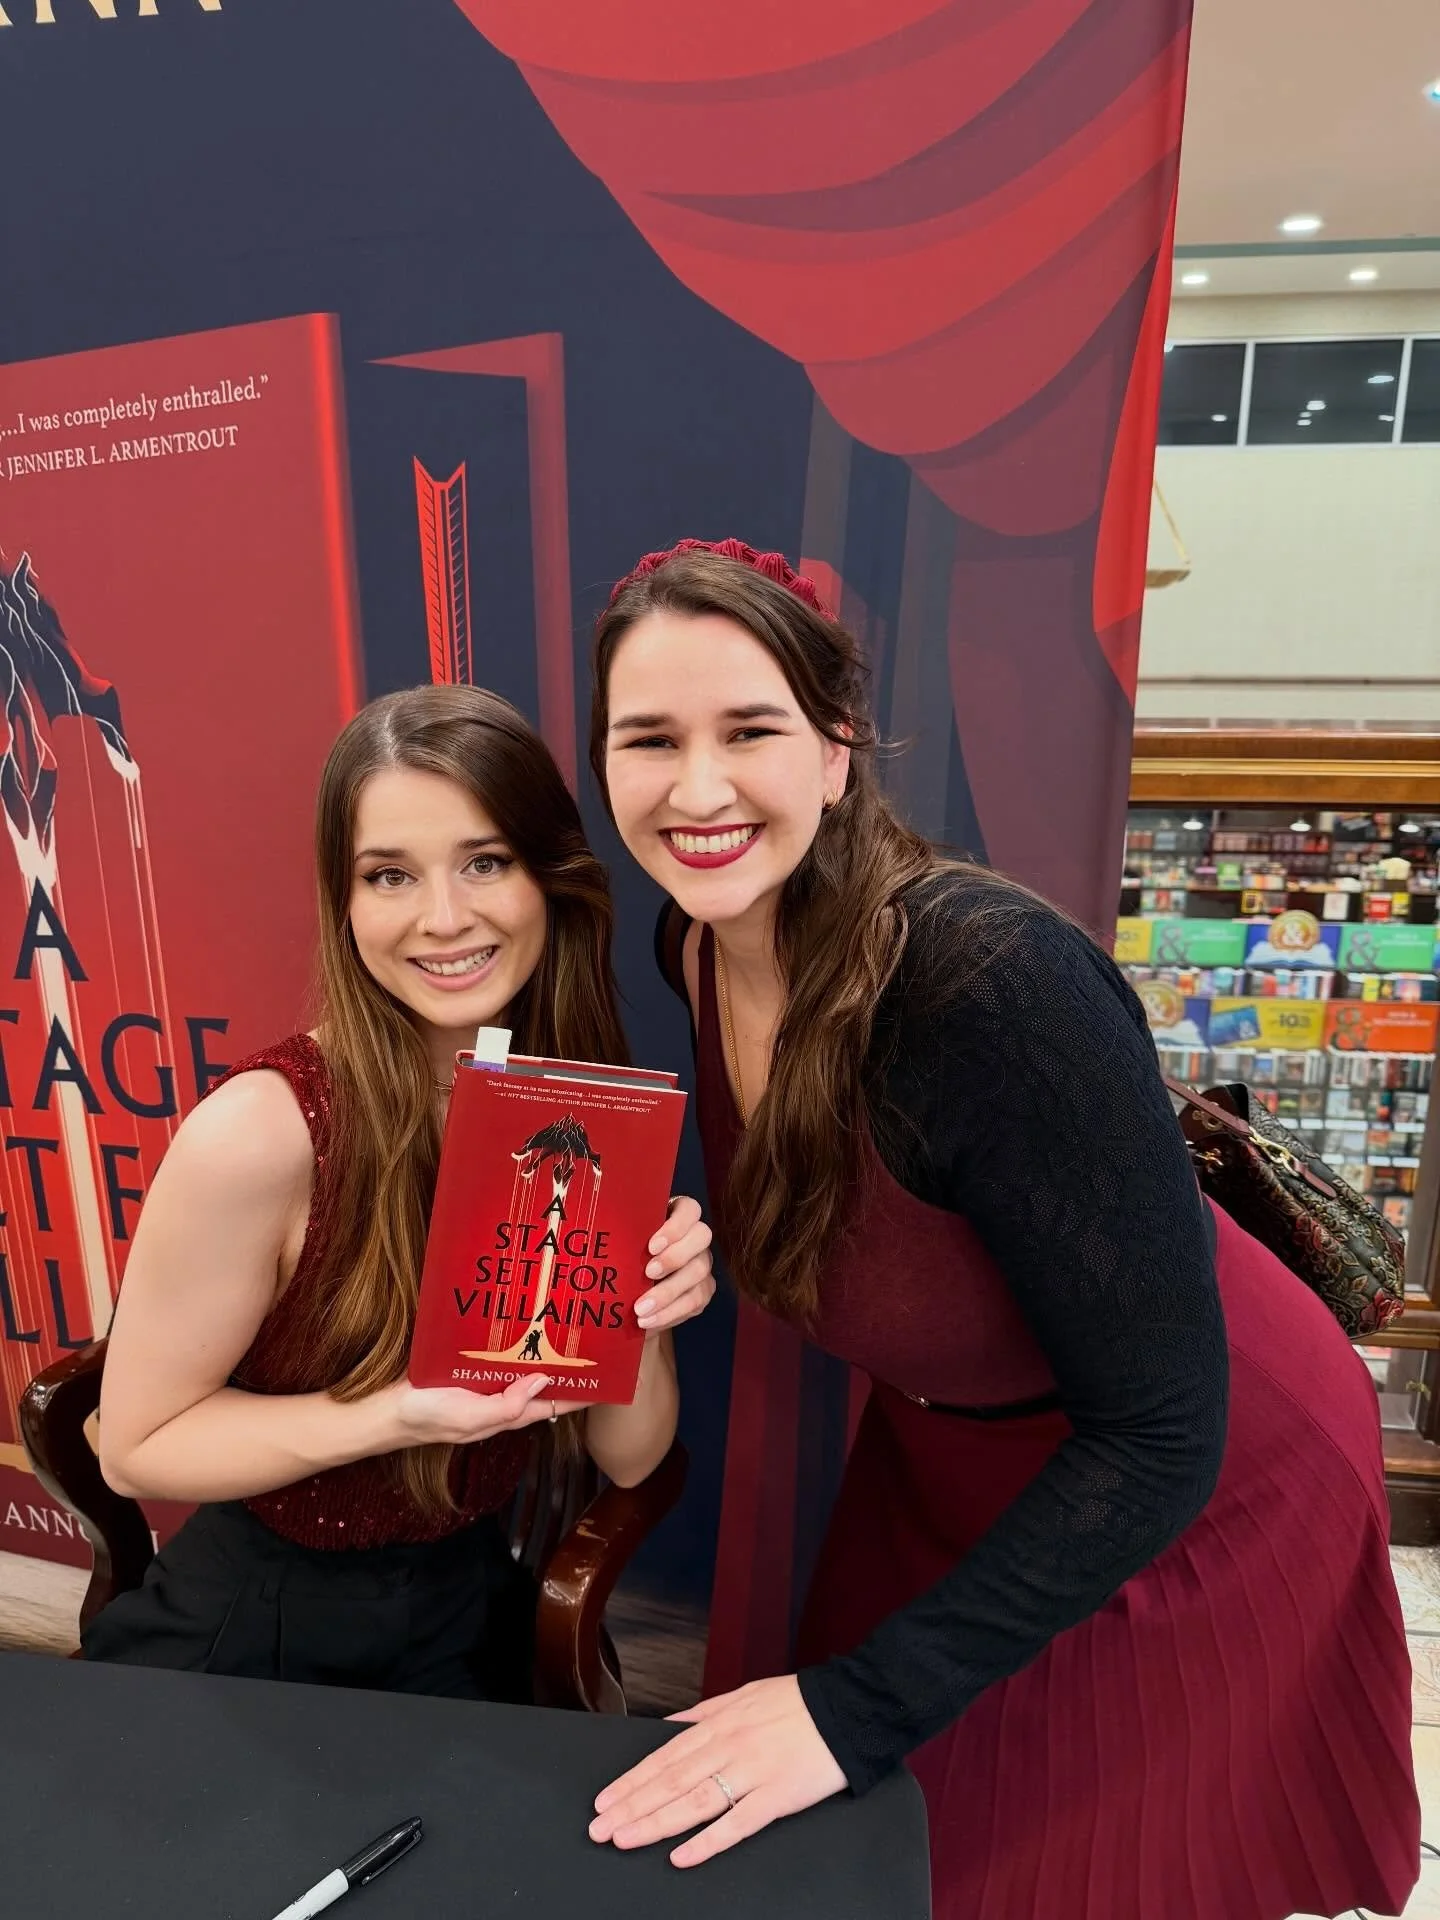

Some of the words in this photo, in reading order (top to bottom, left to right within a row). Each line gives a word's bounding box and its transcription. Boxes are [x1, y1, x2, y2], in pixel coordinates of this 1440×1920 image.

[29, 414, 60, 432] was
[64, 393, 158, 429] completely
[163, 374, 269, 413] enthralled.”
[7, 447, 88, 480] JENNIFER
[90, 445, 105, 465] L.
[109, 425, 239, 463] ARMENTROUT
[14, 876, 89, 982] A
[541, 1193, 567, 1221] A
[495, 1222, 610, 1259] STAGE
[475, 1256, 541, 1287] SET
[551, 1262, 618, 1294] FOR
[453, 1287, 625, 1329] VILLAINS
[549, 1375, 600, 1389] SPANN
